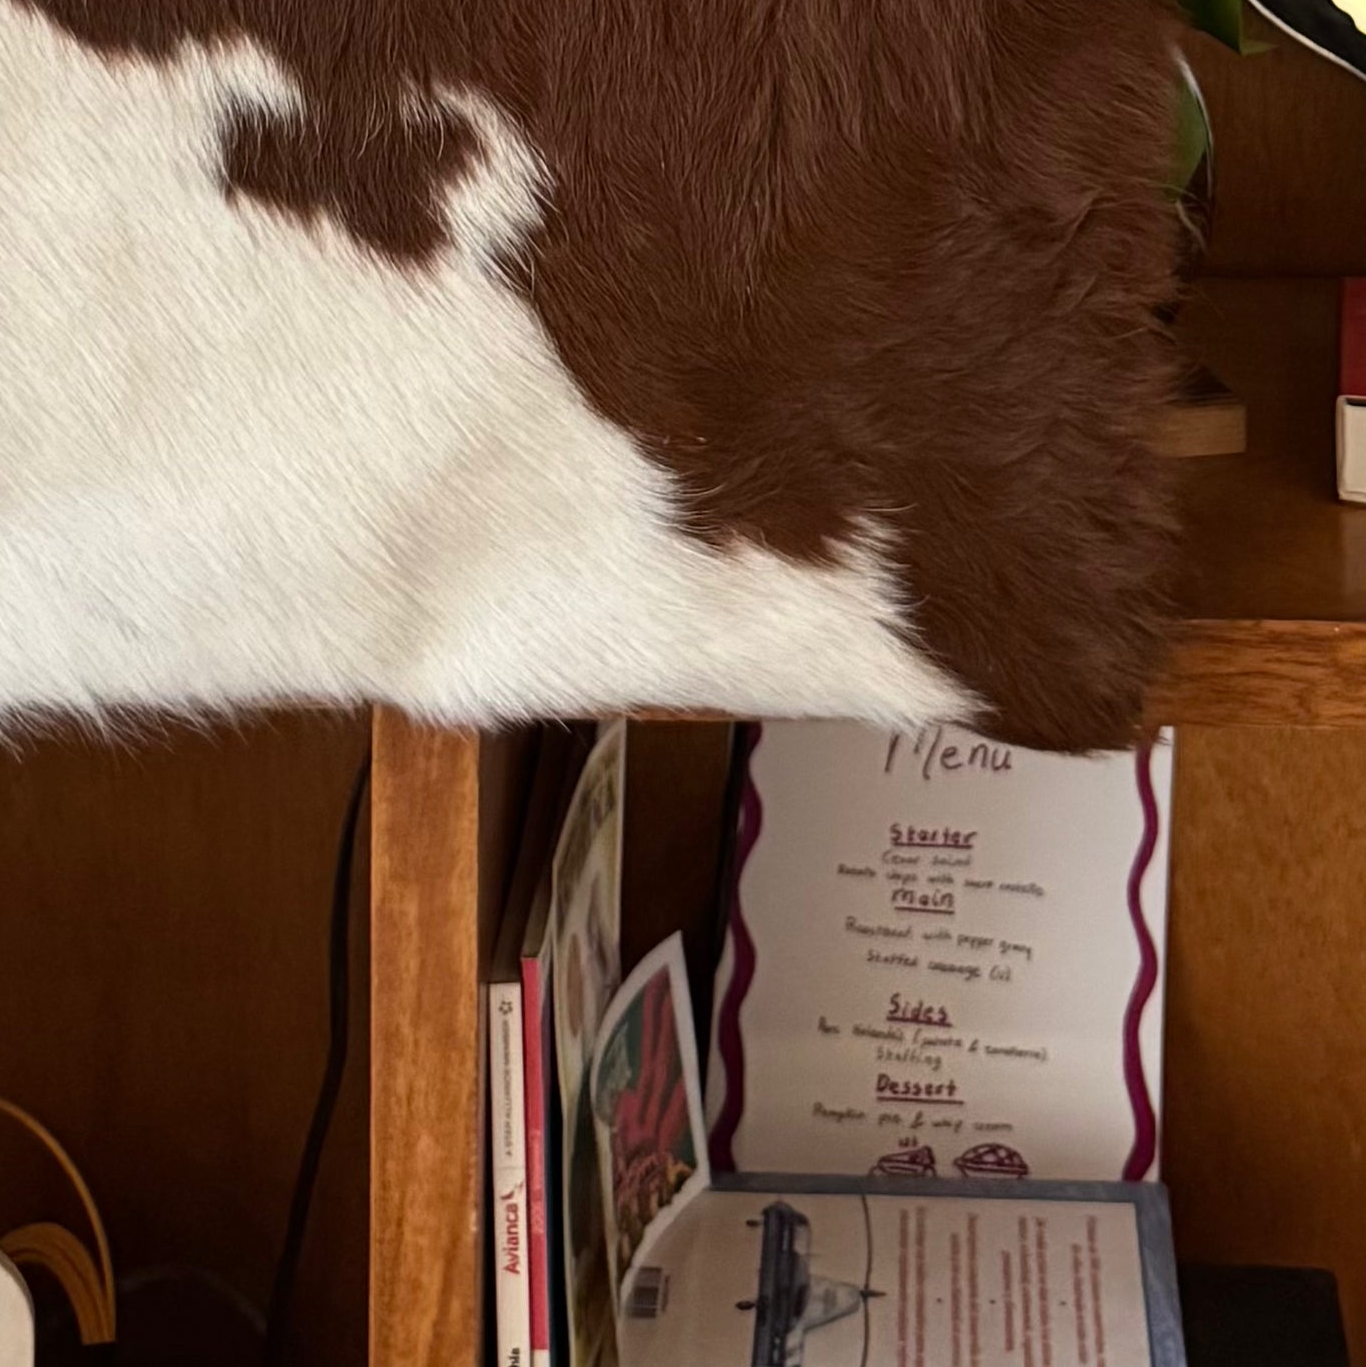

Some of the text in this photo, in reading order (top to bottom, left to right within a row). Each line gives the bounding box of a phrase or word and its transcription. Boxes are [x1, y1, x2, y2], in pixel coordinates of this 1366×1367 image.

[891, 888, 954, 910] Main
[889, 993, 949, 1025] Sides
[876, 1073, 957, 1096] Dessert
[503, 1202, 520, 1275] Avianca
